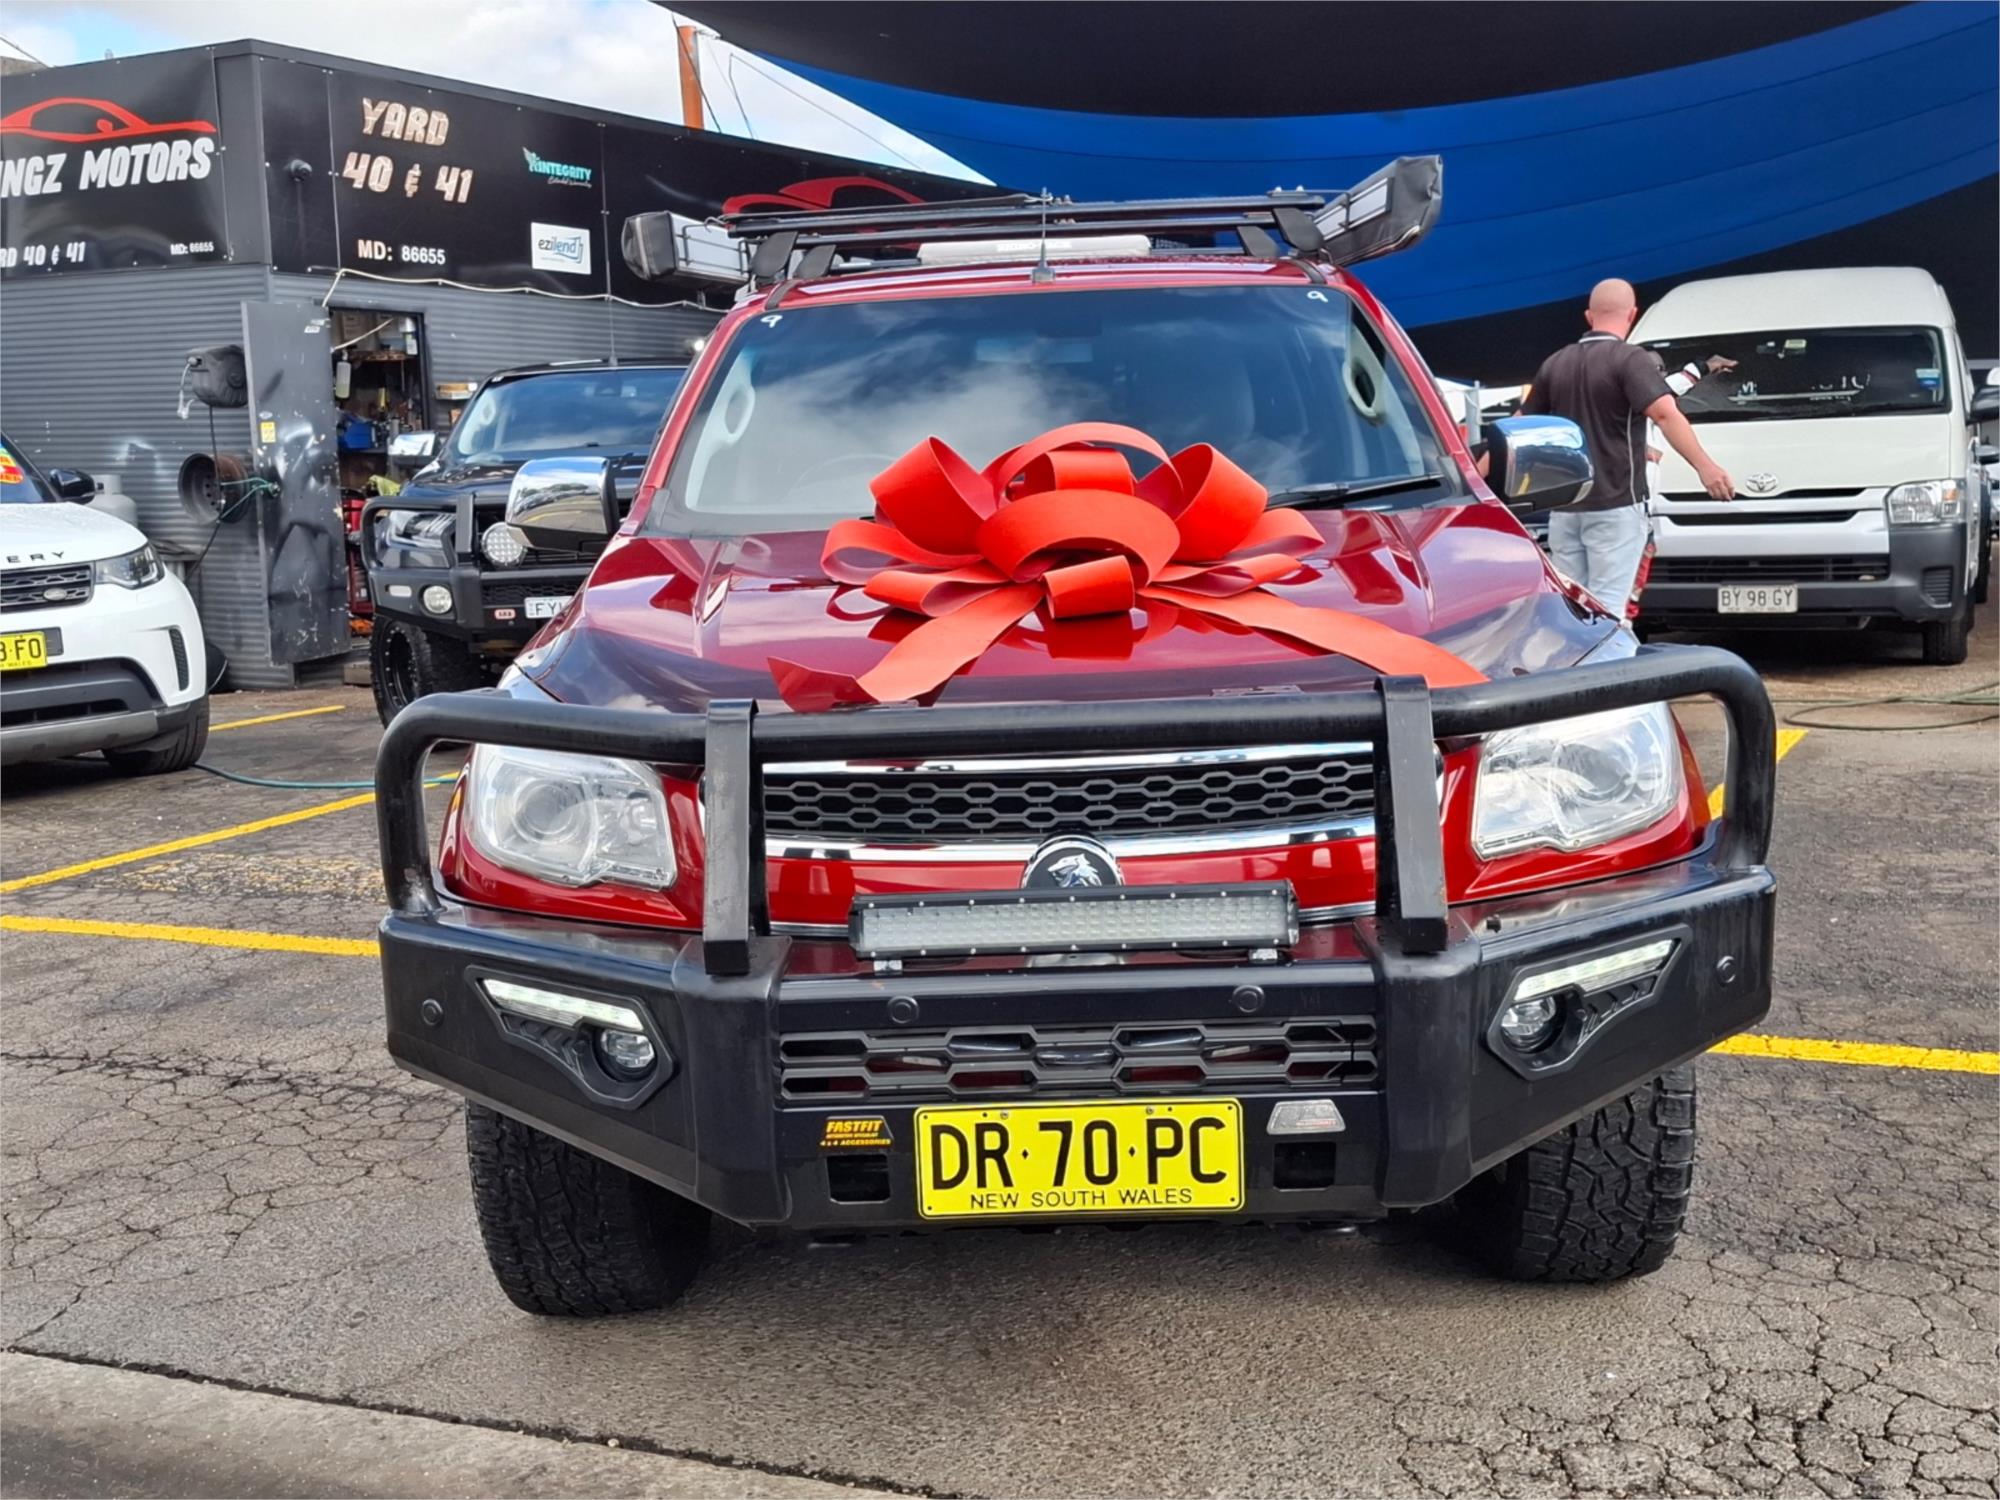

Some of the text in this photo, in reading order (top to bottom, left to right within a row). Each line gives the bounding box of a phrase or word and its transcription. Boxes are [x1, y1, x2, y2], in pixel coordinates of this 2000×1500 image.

[362, 97, 450, 146] YARD
[79, 136, 215, 190] MOTORS
[342, 151, 394, 193] 40
[434, 165, 474, 203] 41
[23, 244, 46, 266] 40
[66, 241, 86, 262] 41
[358, 238, 446, 265] MD: 86655
[6, 550, 65, 564] ERY
[1721, 588, 1793, 607] BY 98 GY
[826, 1120, 882, 1133] FASTFIT
[970, 1187, 1193, 1210] NEW SOUTH WALES
